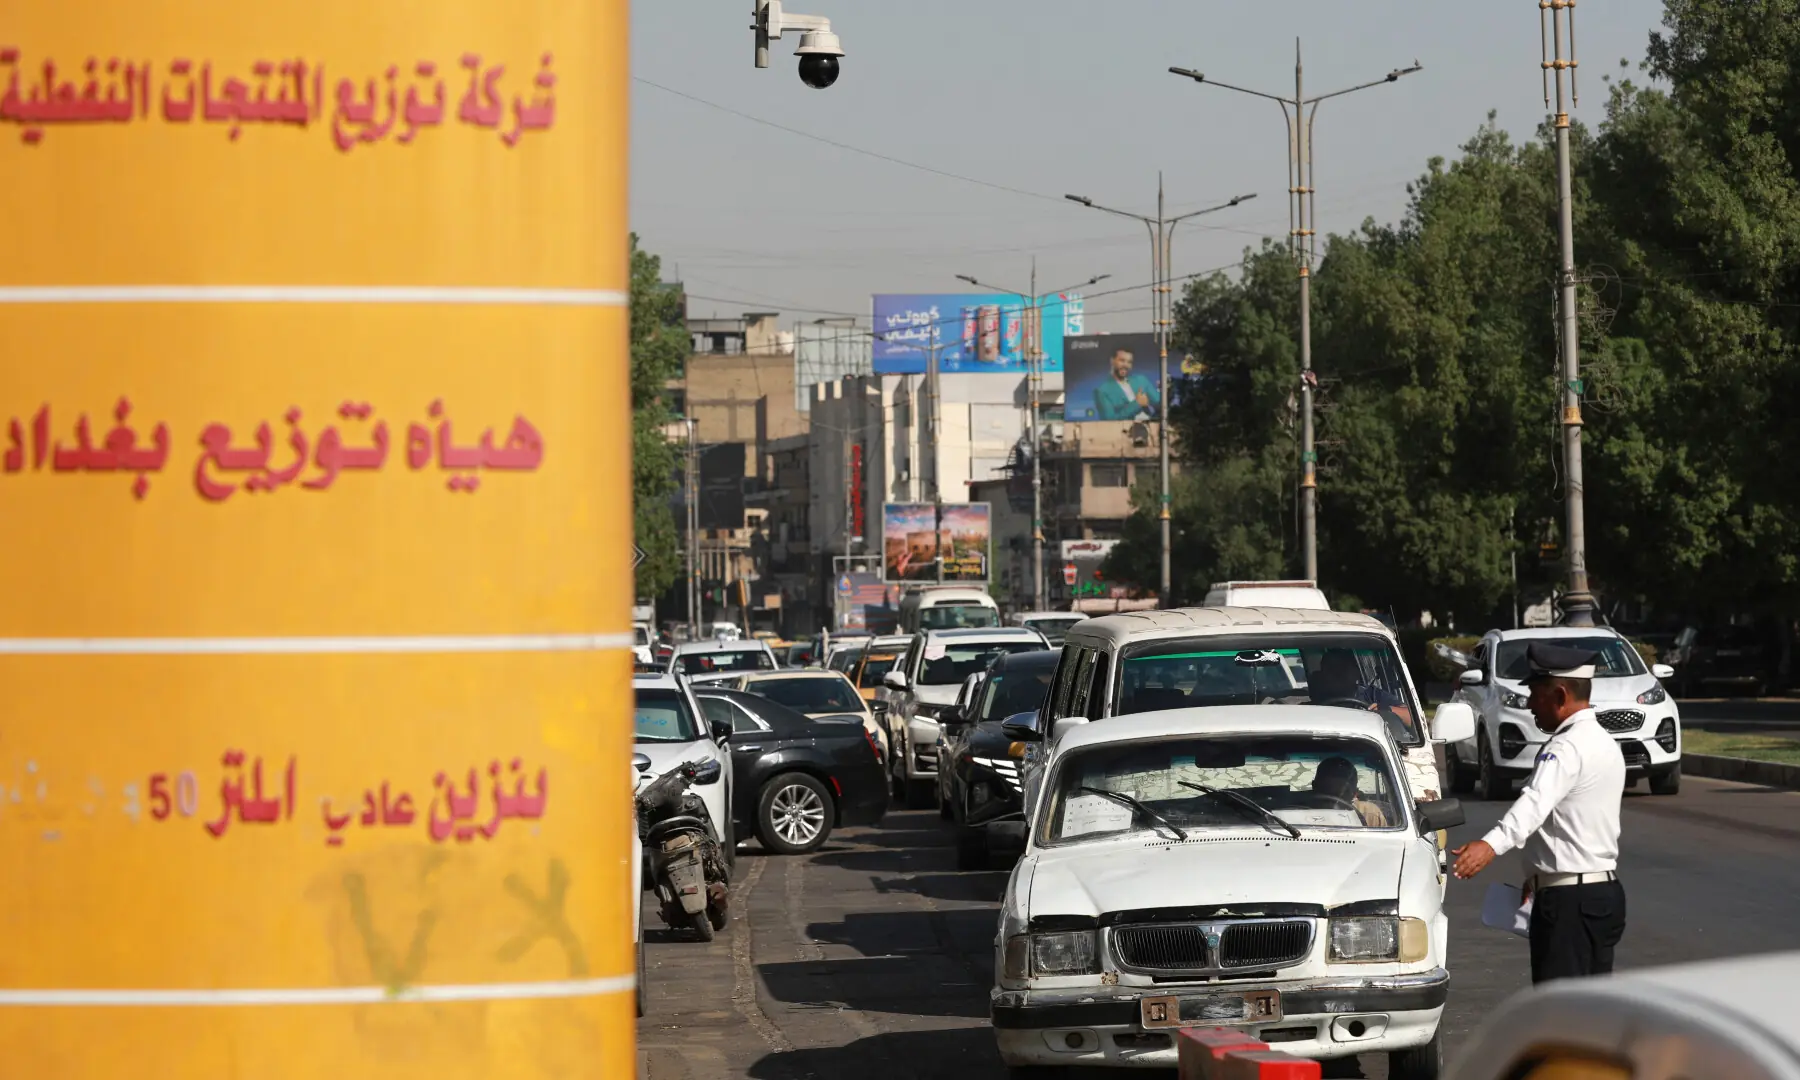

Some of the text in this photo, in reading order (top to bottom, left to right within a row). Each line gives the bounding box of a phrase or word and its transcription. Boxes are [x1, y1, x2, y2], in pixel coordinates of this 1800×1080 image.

[0, 46, 555, 153] شركة توزيع المنتجات النفطية
[1, 396, 171, 501] بغداد
[193, 401, 390, 503] توزيع
